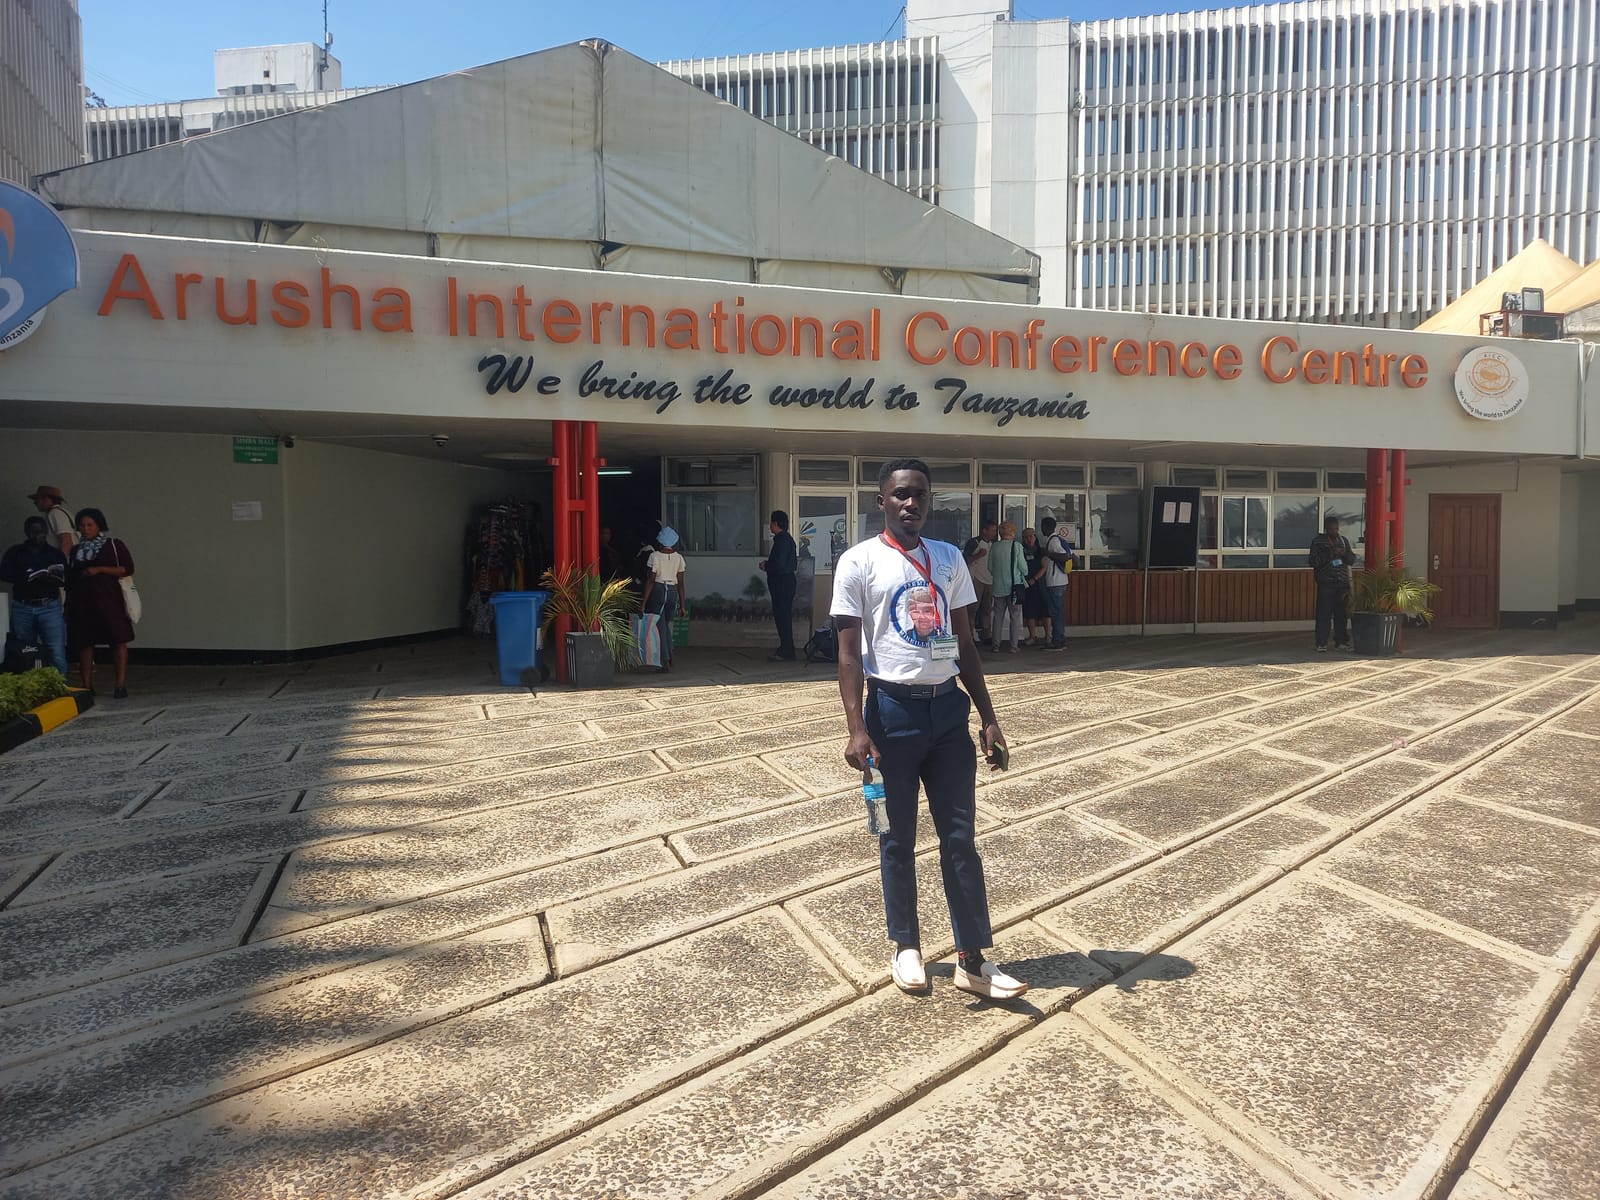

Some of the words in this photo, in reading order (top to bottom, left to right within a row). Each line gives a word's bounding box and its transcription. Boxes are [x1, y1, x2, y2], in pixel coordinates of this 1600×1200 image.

[0, 319, 34, 345] anzania
[97, 252, 412, 333] Arusha
[447, 277, 881, 362] International
[904, 311, 1243, 380] Conference
[1260, 336, 1428, 388] Centre
[477, 354, 561, 397] We
[578, 359, 682, 415] bring
[692, 368, 753, 406] the
[768, 377, 875, 411] world
[883, 384, 920, 411] to
[934, 377, 1090, 428] Tanzania
[1463, 399, 1474, 412] bring
[1474, 408, 1482, 417] the
[1503, 398, 1523, 415] Tanzania
